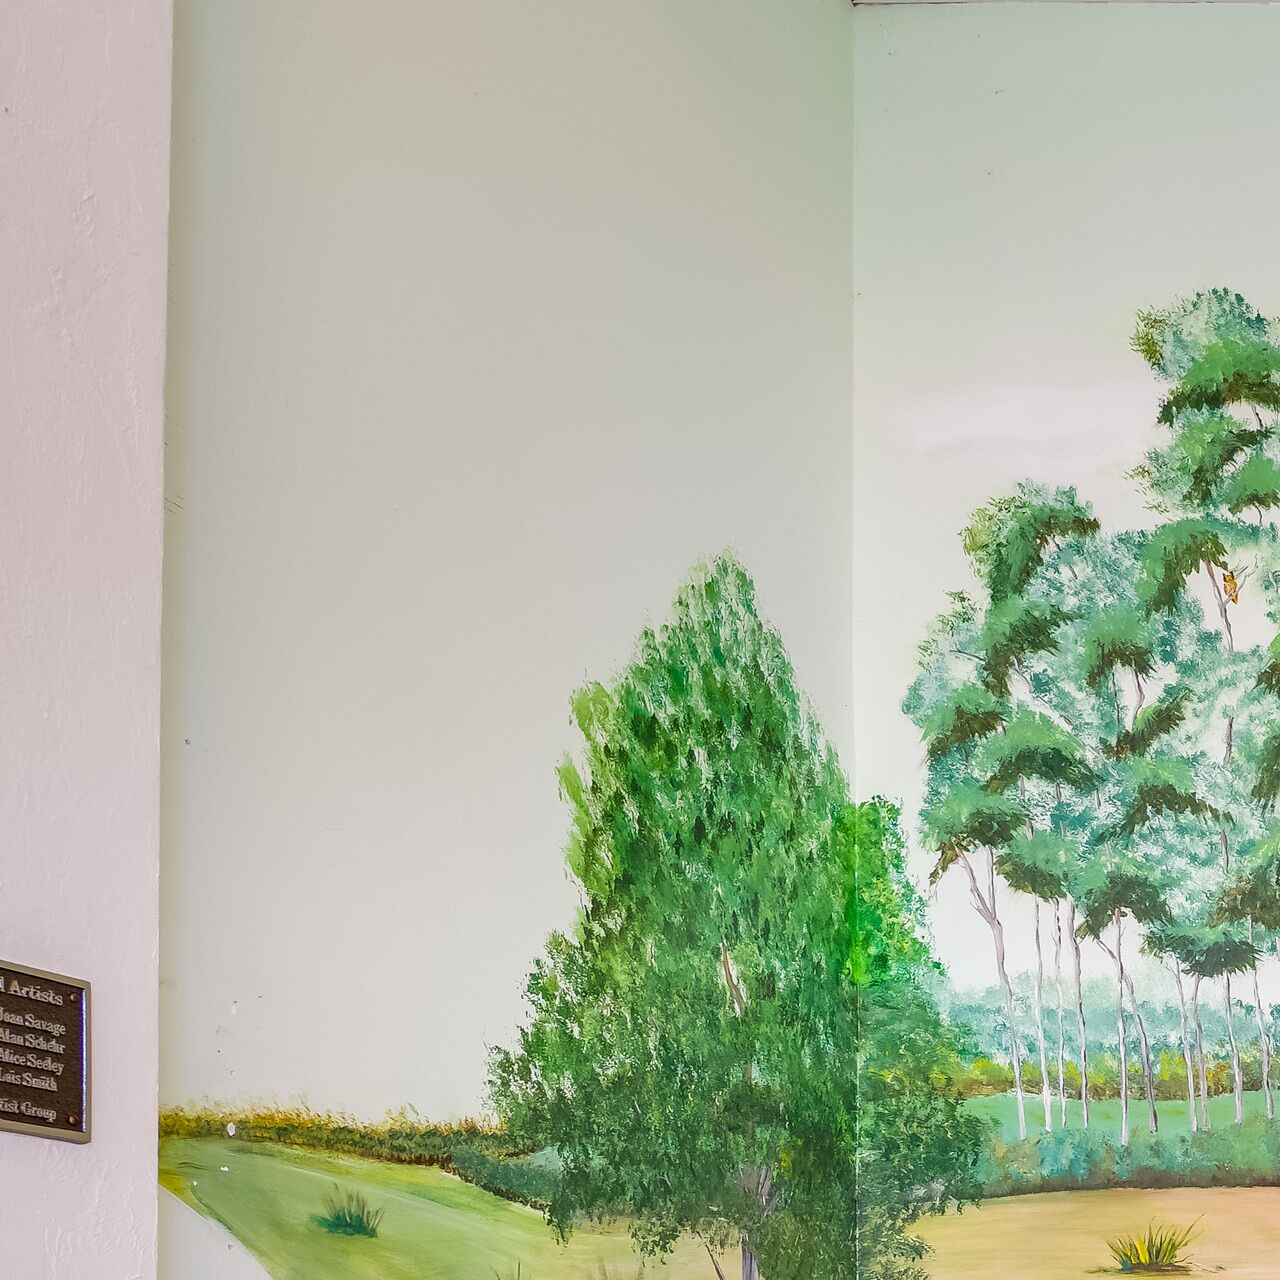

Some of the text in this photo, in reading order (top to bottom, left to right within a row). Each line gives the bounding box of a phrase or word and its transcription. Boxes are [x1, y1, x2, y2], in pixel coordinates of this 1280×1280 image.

[8, 979, 63, 1006] Artists
[25, 1013, 66, 1037] Savage
[27, 1053, 65, 1076] Seeley
[22, 1072, 58, 1092] Smith
[21, 1101, 57, 1123] Group
